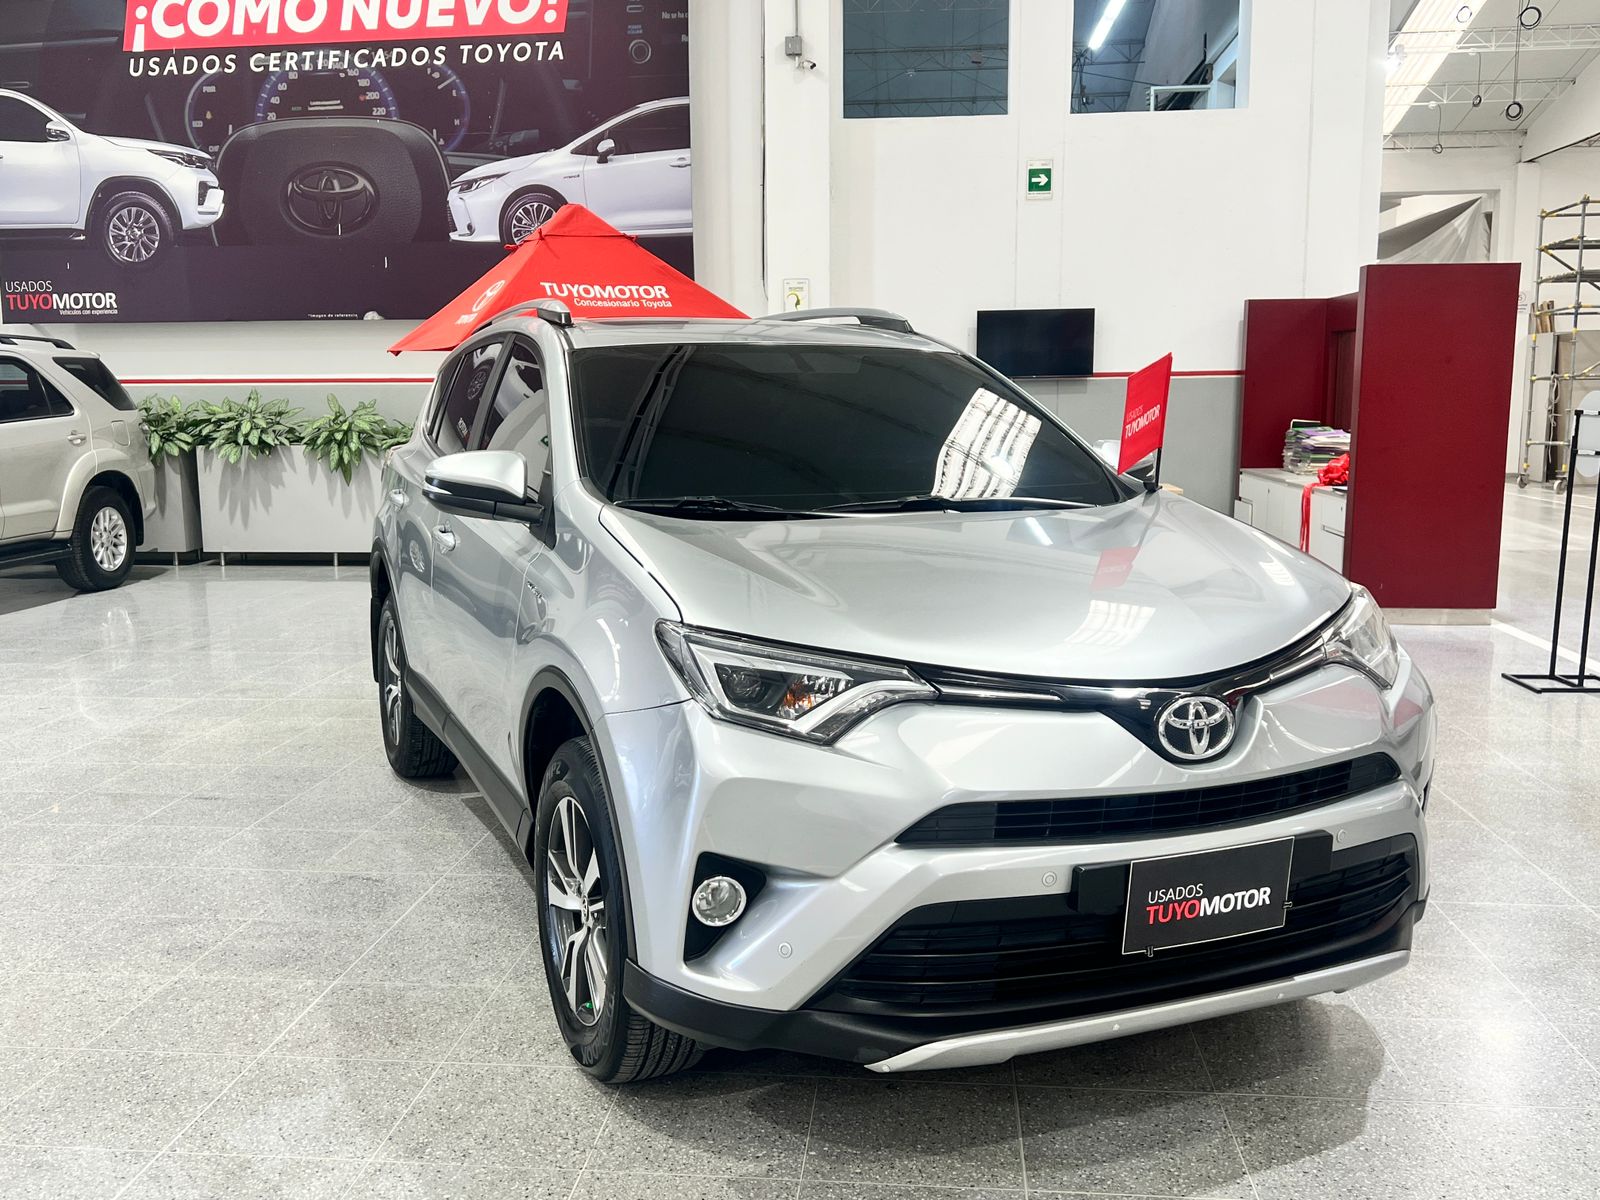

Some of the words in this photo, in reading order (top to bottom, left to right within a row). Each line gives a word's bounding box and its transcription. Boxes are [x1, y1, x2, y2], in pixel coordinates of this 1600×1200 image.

[132, 0, 328, 52] ¡COMO
[129, 54, 237, 77] USADOS
[250, 46, 447, 72] CERTIFICADOS
[459, 41, 564, 64] TOYOTA
[277, 82, 287, 91] 60
[270, 96, 280, 104] 40
[366, 91, 379, 100] 200
[267, 112, 277, 120] 20
[372, 107, 386, 115] 220
[5, 281, 53, 292] USADOS
[539, 282, 670, 299] TUYOMOTOR
[6, 292, 118, 310] TUYOMOTOR
[574, 298, 640, 307] Concesionario
[642, 299, 672, 309] Toyota
[1125, 404, 1160, 439] TUYOMOTOR
[1148, 883, 1204, 904] USADOS
[1146, 886, 1271, 925] TUYOMOTOR
